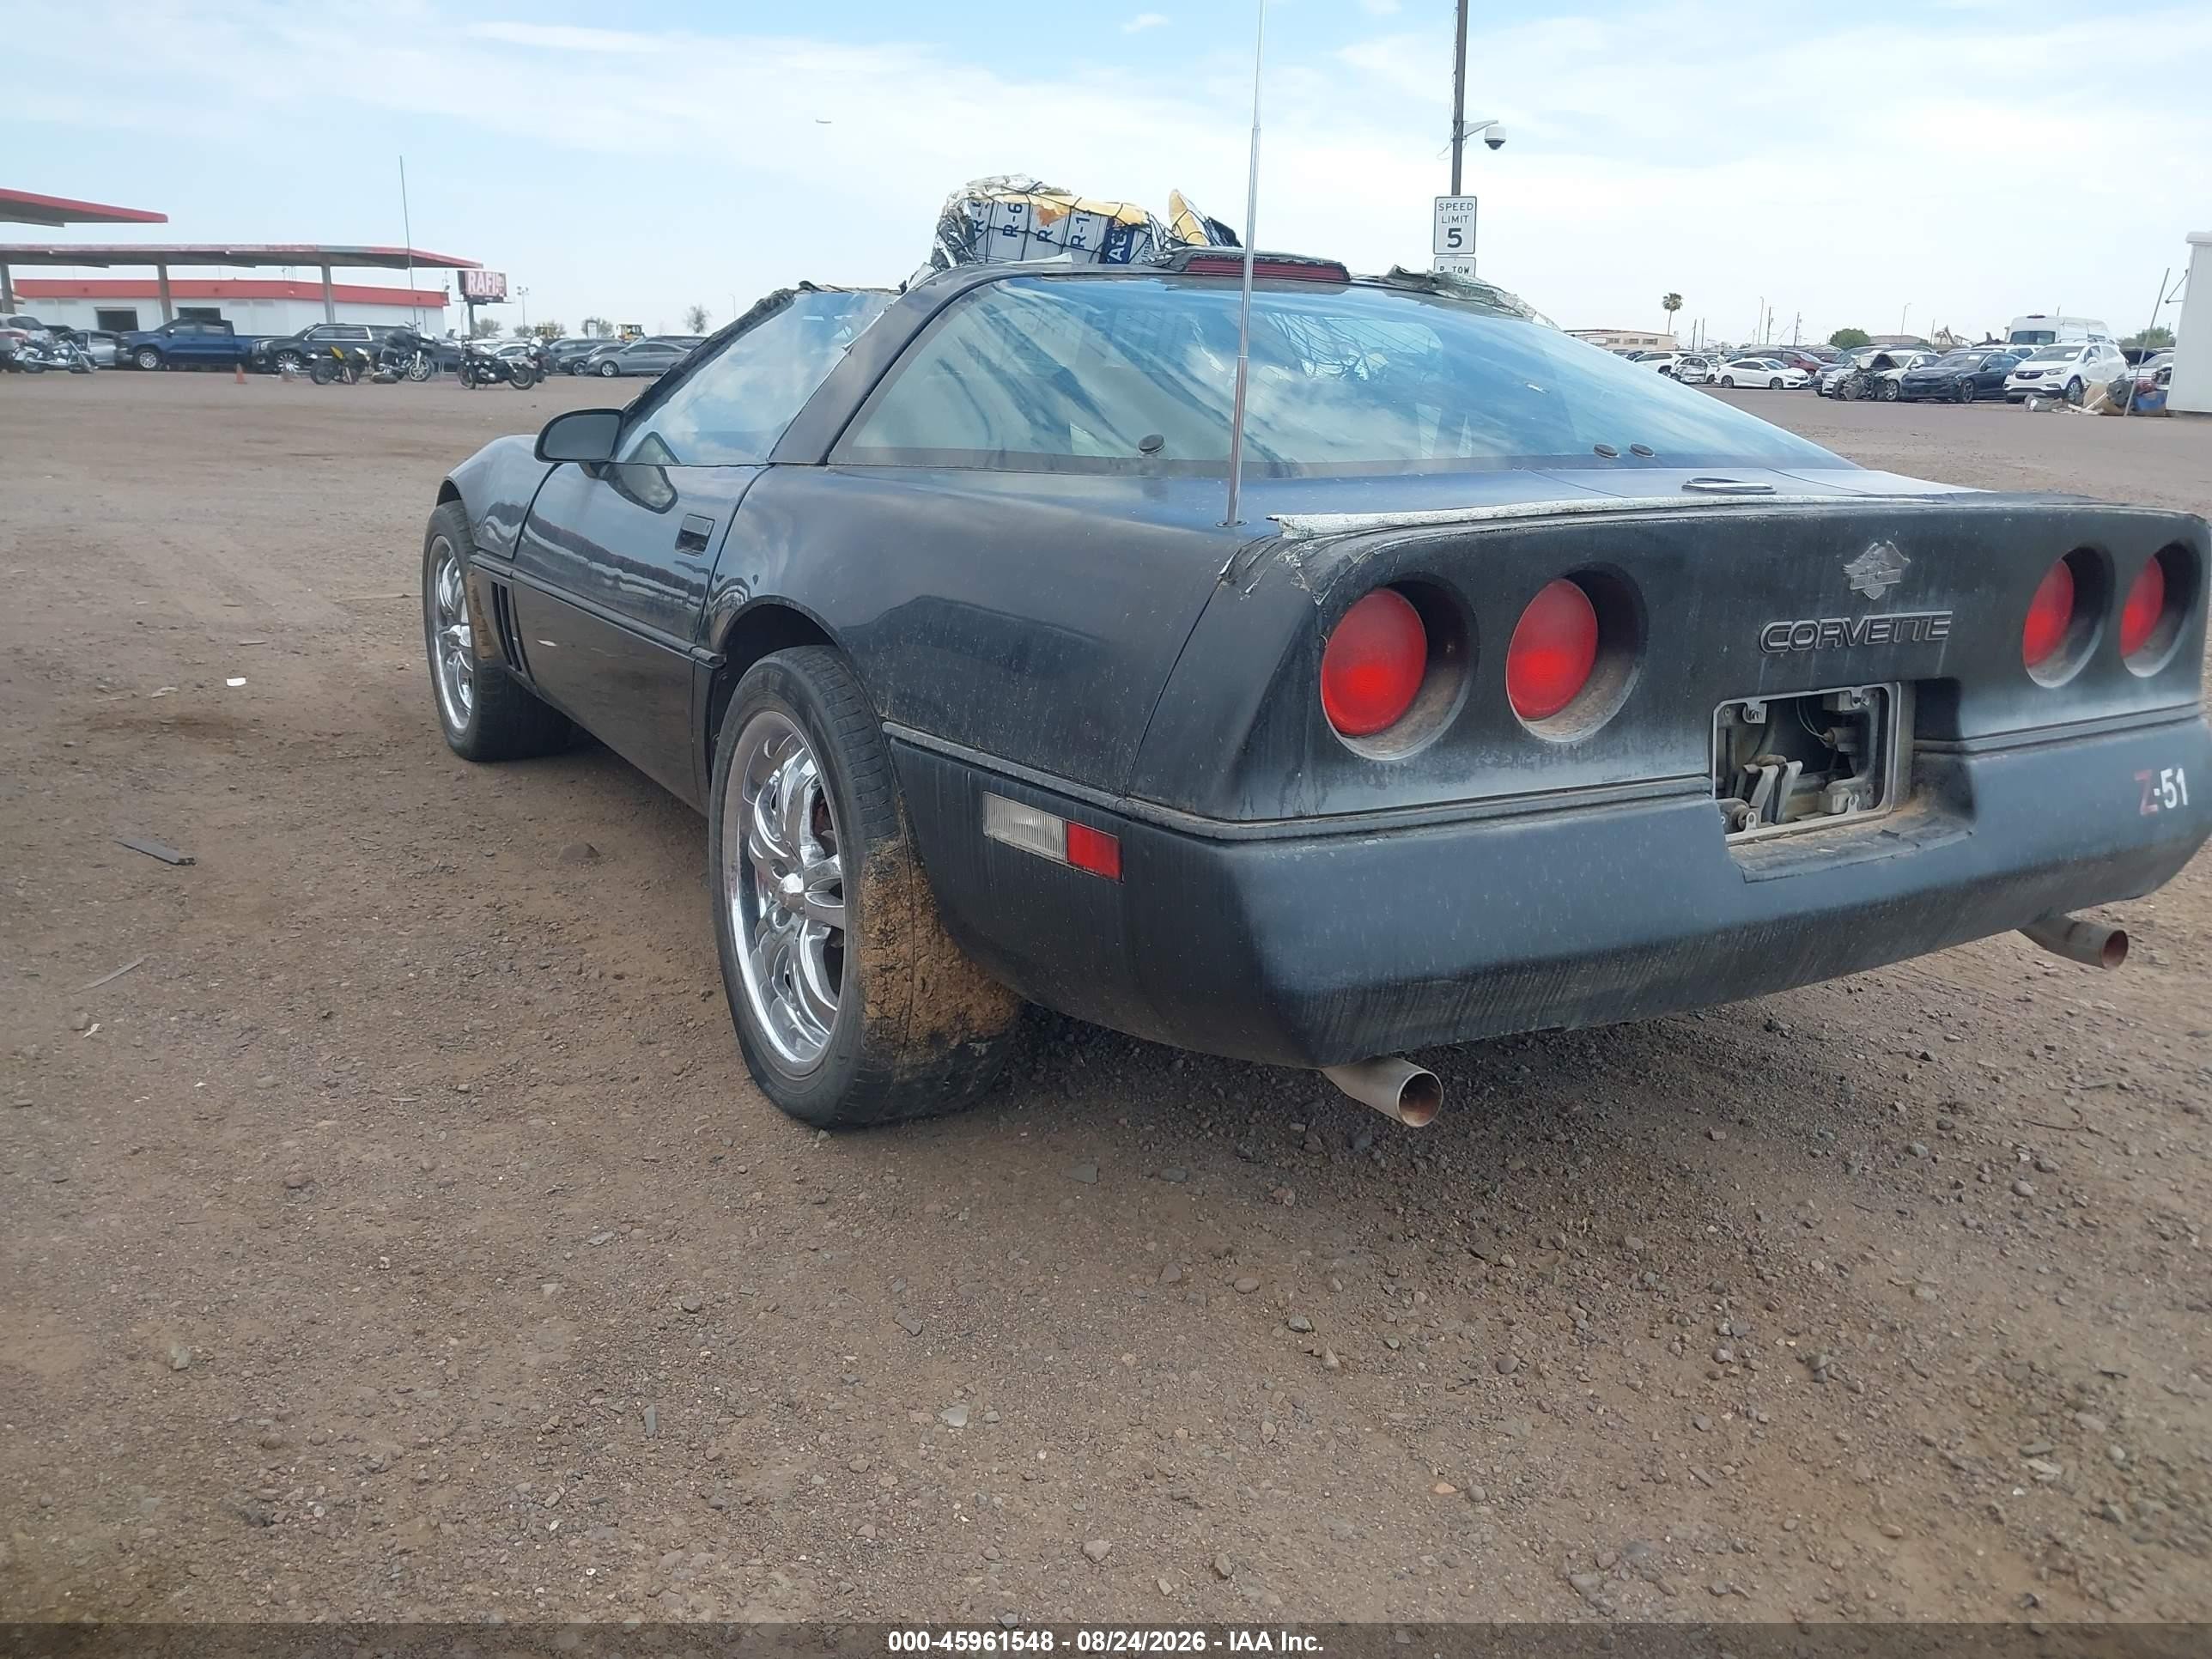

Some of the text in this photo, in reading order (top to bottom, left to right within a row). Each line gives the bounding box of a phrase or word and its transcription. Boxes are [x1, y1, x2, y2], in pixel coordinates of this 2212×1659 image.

[1437, 203, 1474, 211] SPEED
[1002, 204, 1023, 238] R-6
[1441, 215, 1468, 224] LIMIT
[1447, 228, 1462, 248] 5
[1451, 265, 1470, 275] TOW
[1759, 611, 1954, 653] CORVETTE
